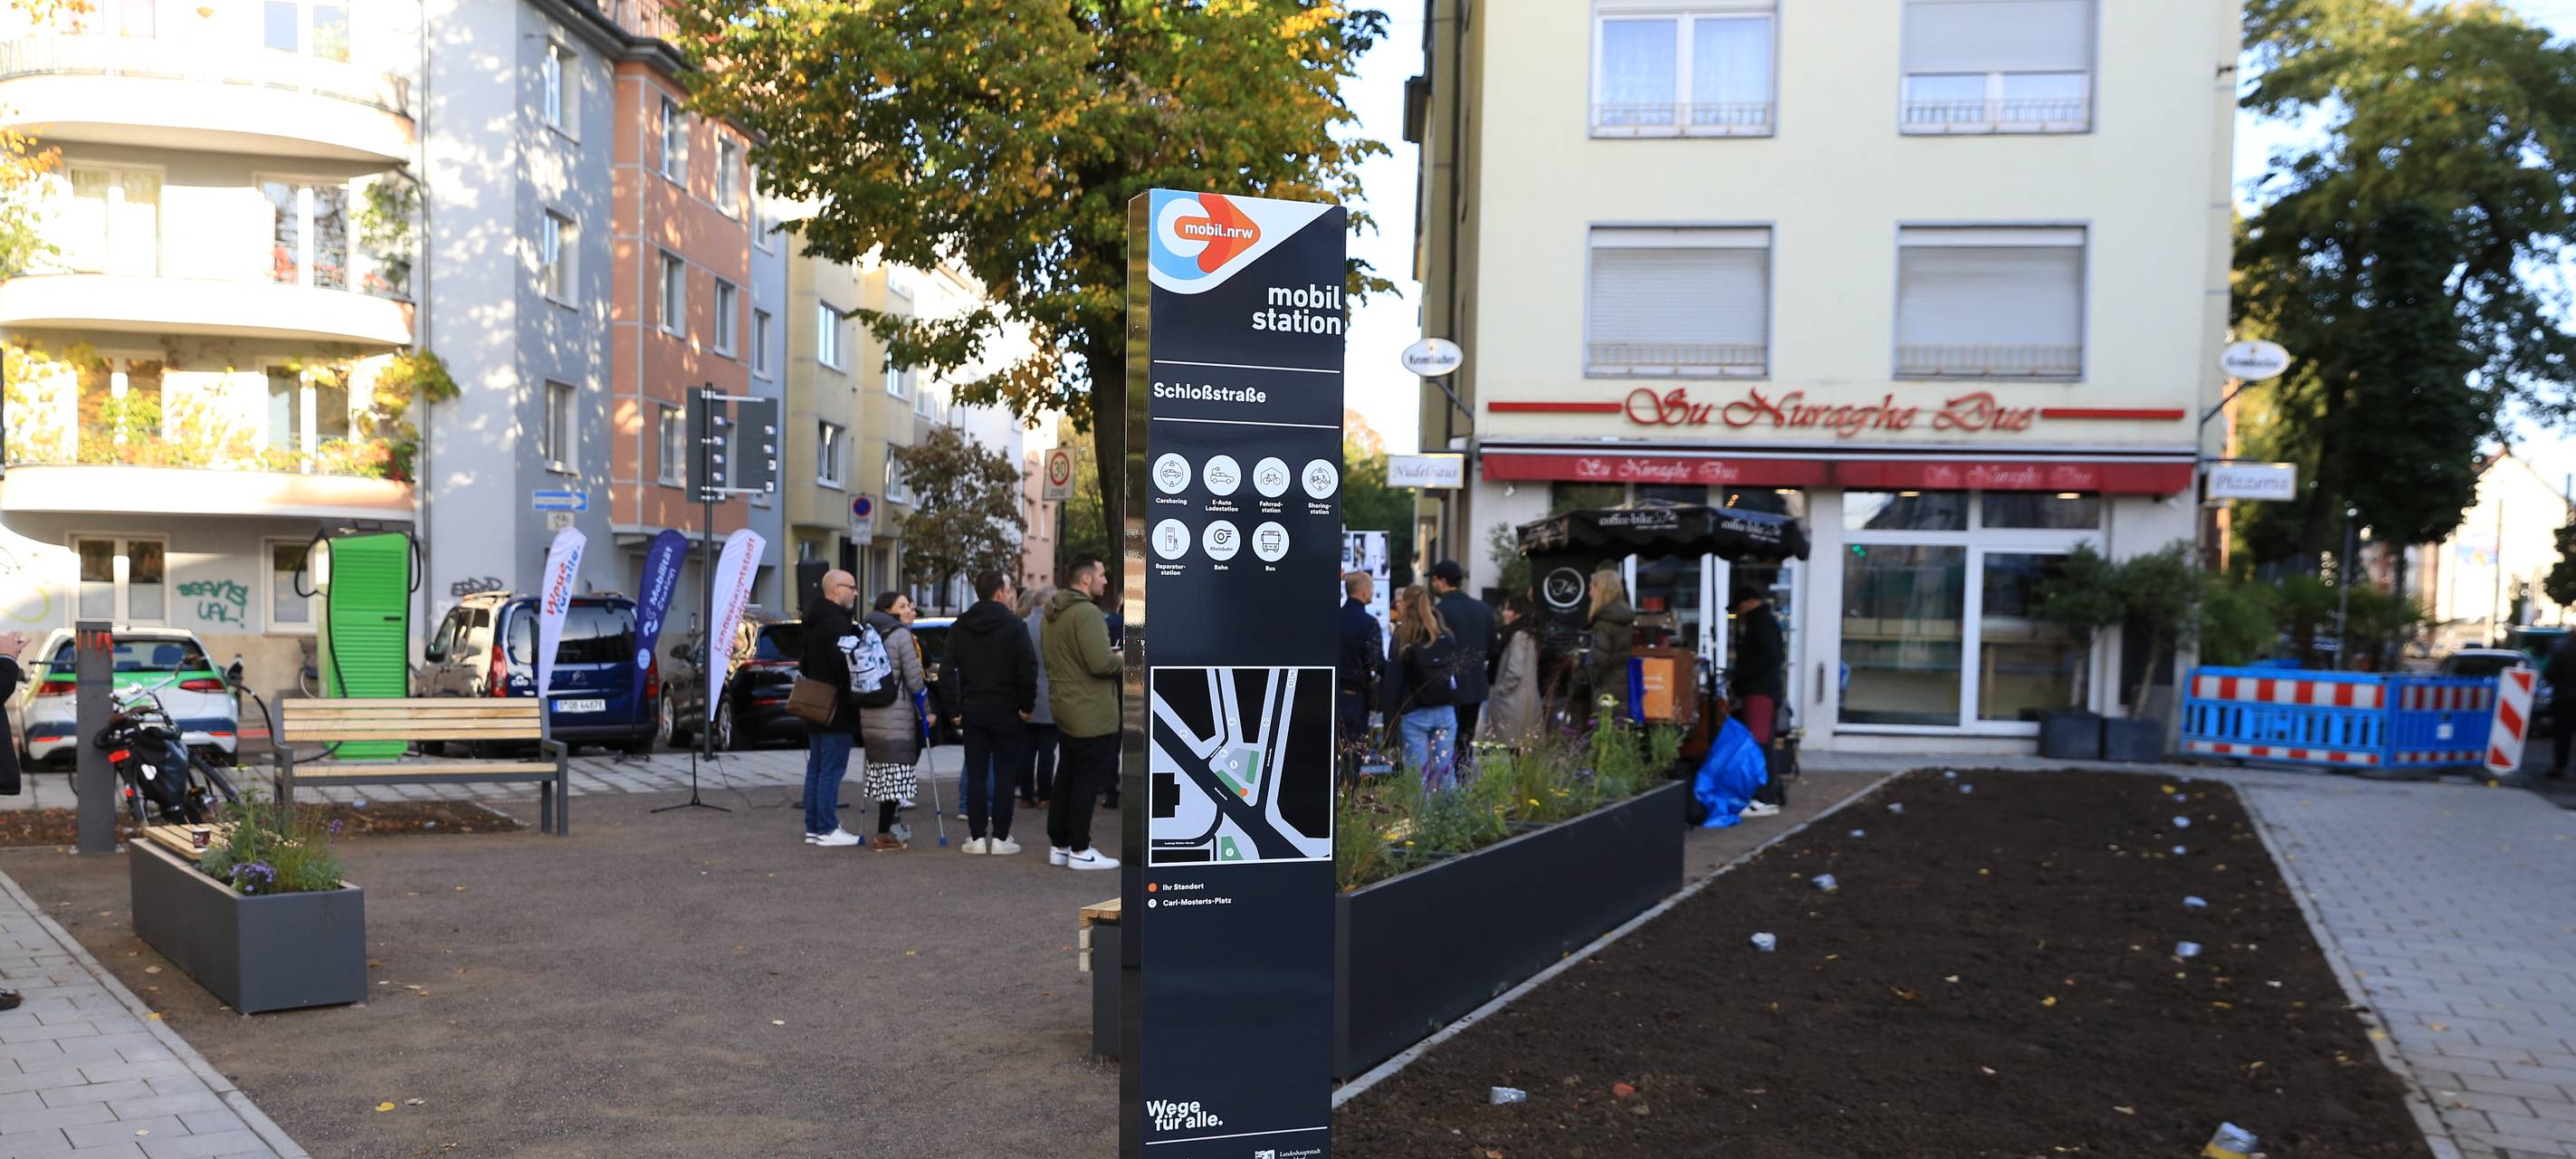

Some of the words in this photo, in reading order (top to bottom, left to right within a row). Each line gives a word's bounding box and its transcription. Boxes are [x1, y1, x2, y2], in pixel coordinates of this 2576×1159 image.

[1185, 223, 1253, 239] mobil.nrw
[1267, 283, 1341, 310] mobil
[1252, 308, 1341, 335] station
[1153, 381, 1267, 403] Schloßstraße
[1626, 388, 1713, 426] Su
[1722, 387, 1920, 440] Nuraghe
[1931, 391, 2037, 433] Due
[1391, 463, 1457, 479] Nudelhaus
[1155, 498, 1188, 506] Carsharing
[1155, 563, 1187, 571] Reparatur-
[1162, 883, 1173, 891] Ihr
[1173, 882, 1205, 891] Standort
[1146, 1099, 1201, 1118] Wege
[1155, 1116, 1182, 1132] für
[1185, 1111, 1224, 1129] alle.
[1279, 1148, 1321, 1158] Landeshauptstadt
